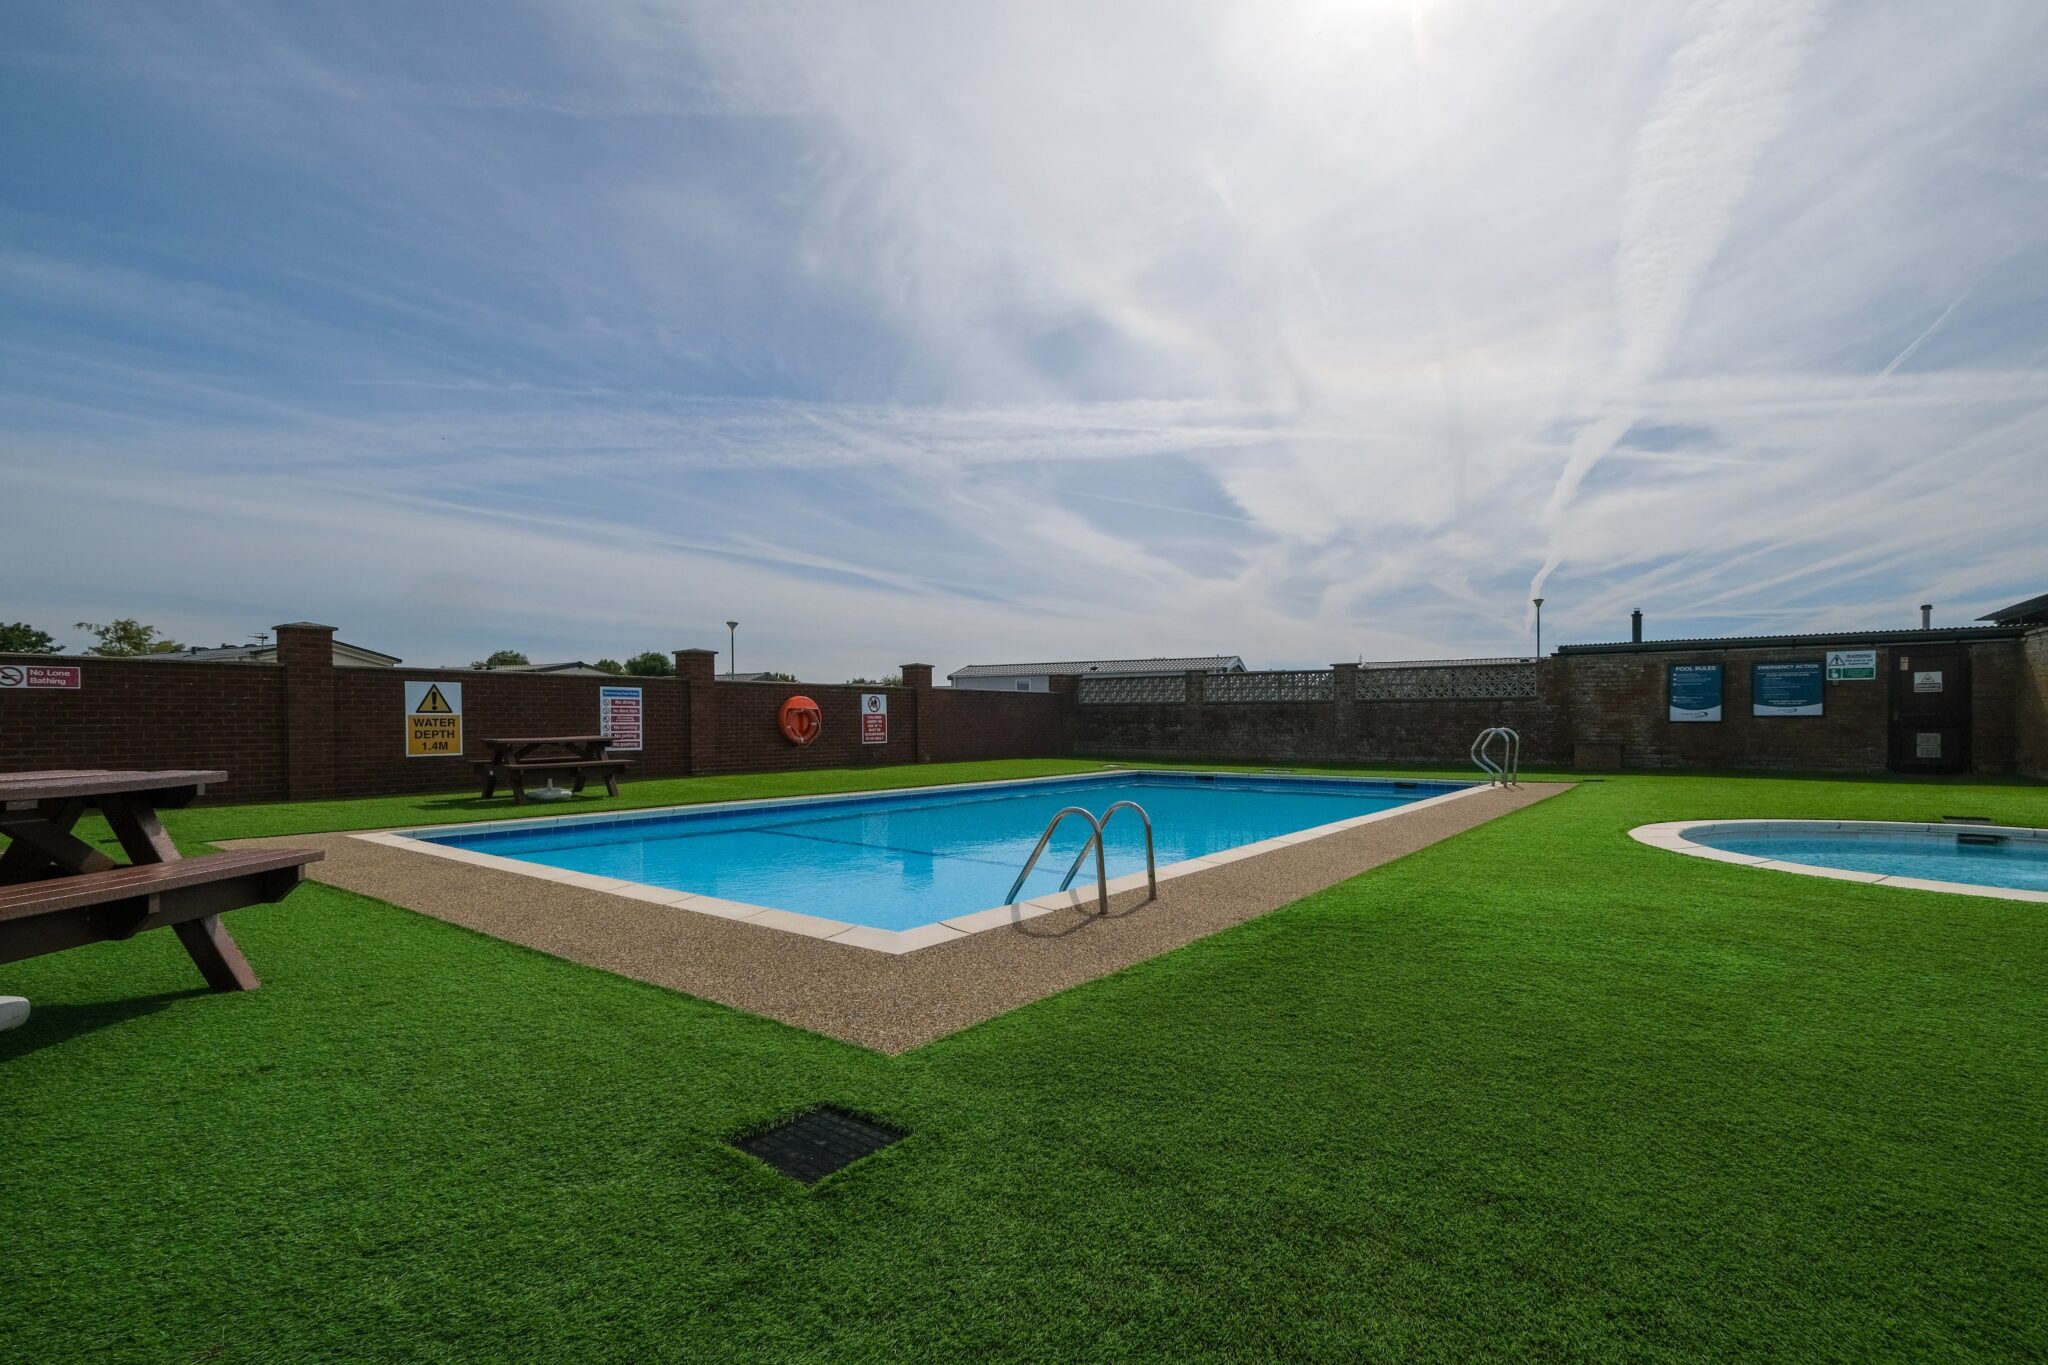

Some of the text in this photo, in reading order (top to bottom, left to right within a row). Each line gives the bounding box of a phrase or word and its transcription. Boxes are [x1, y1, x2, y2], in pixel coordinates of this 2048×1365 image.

[413, 718, 456, 727] WATER
[414, 730, 455, 739] DEPTH
[422, 742, 448, 750] 1.4M
